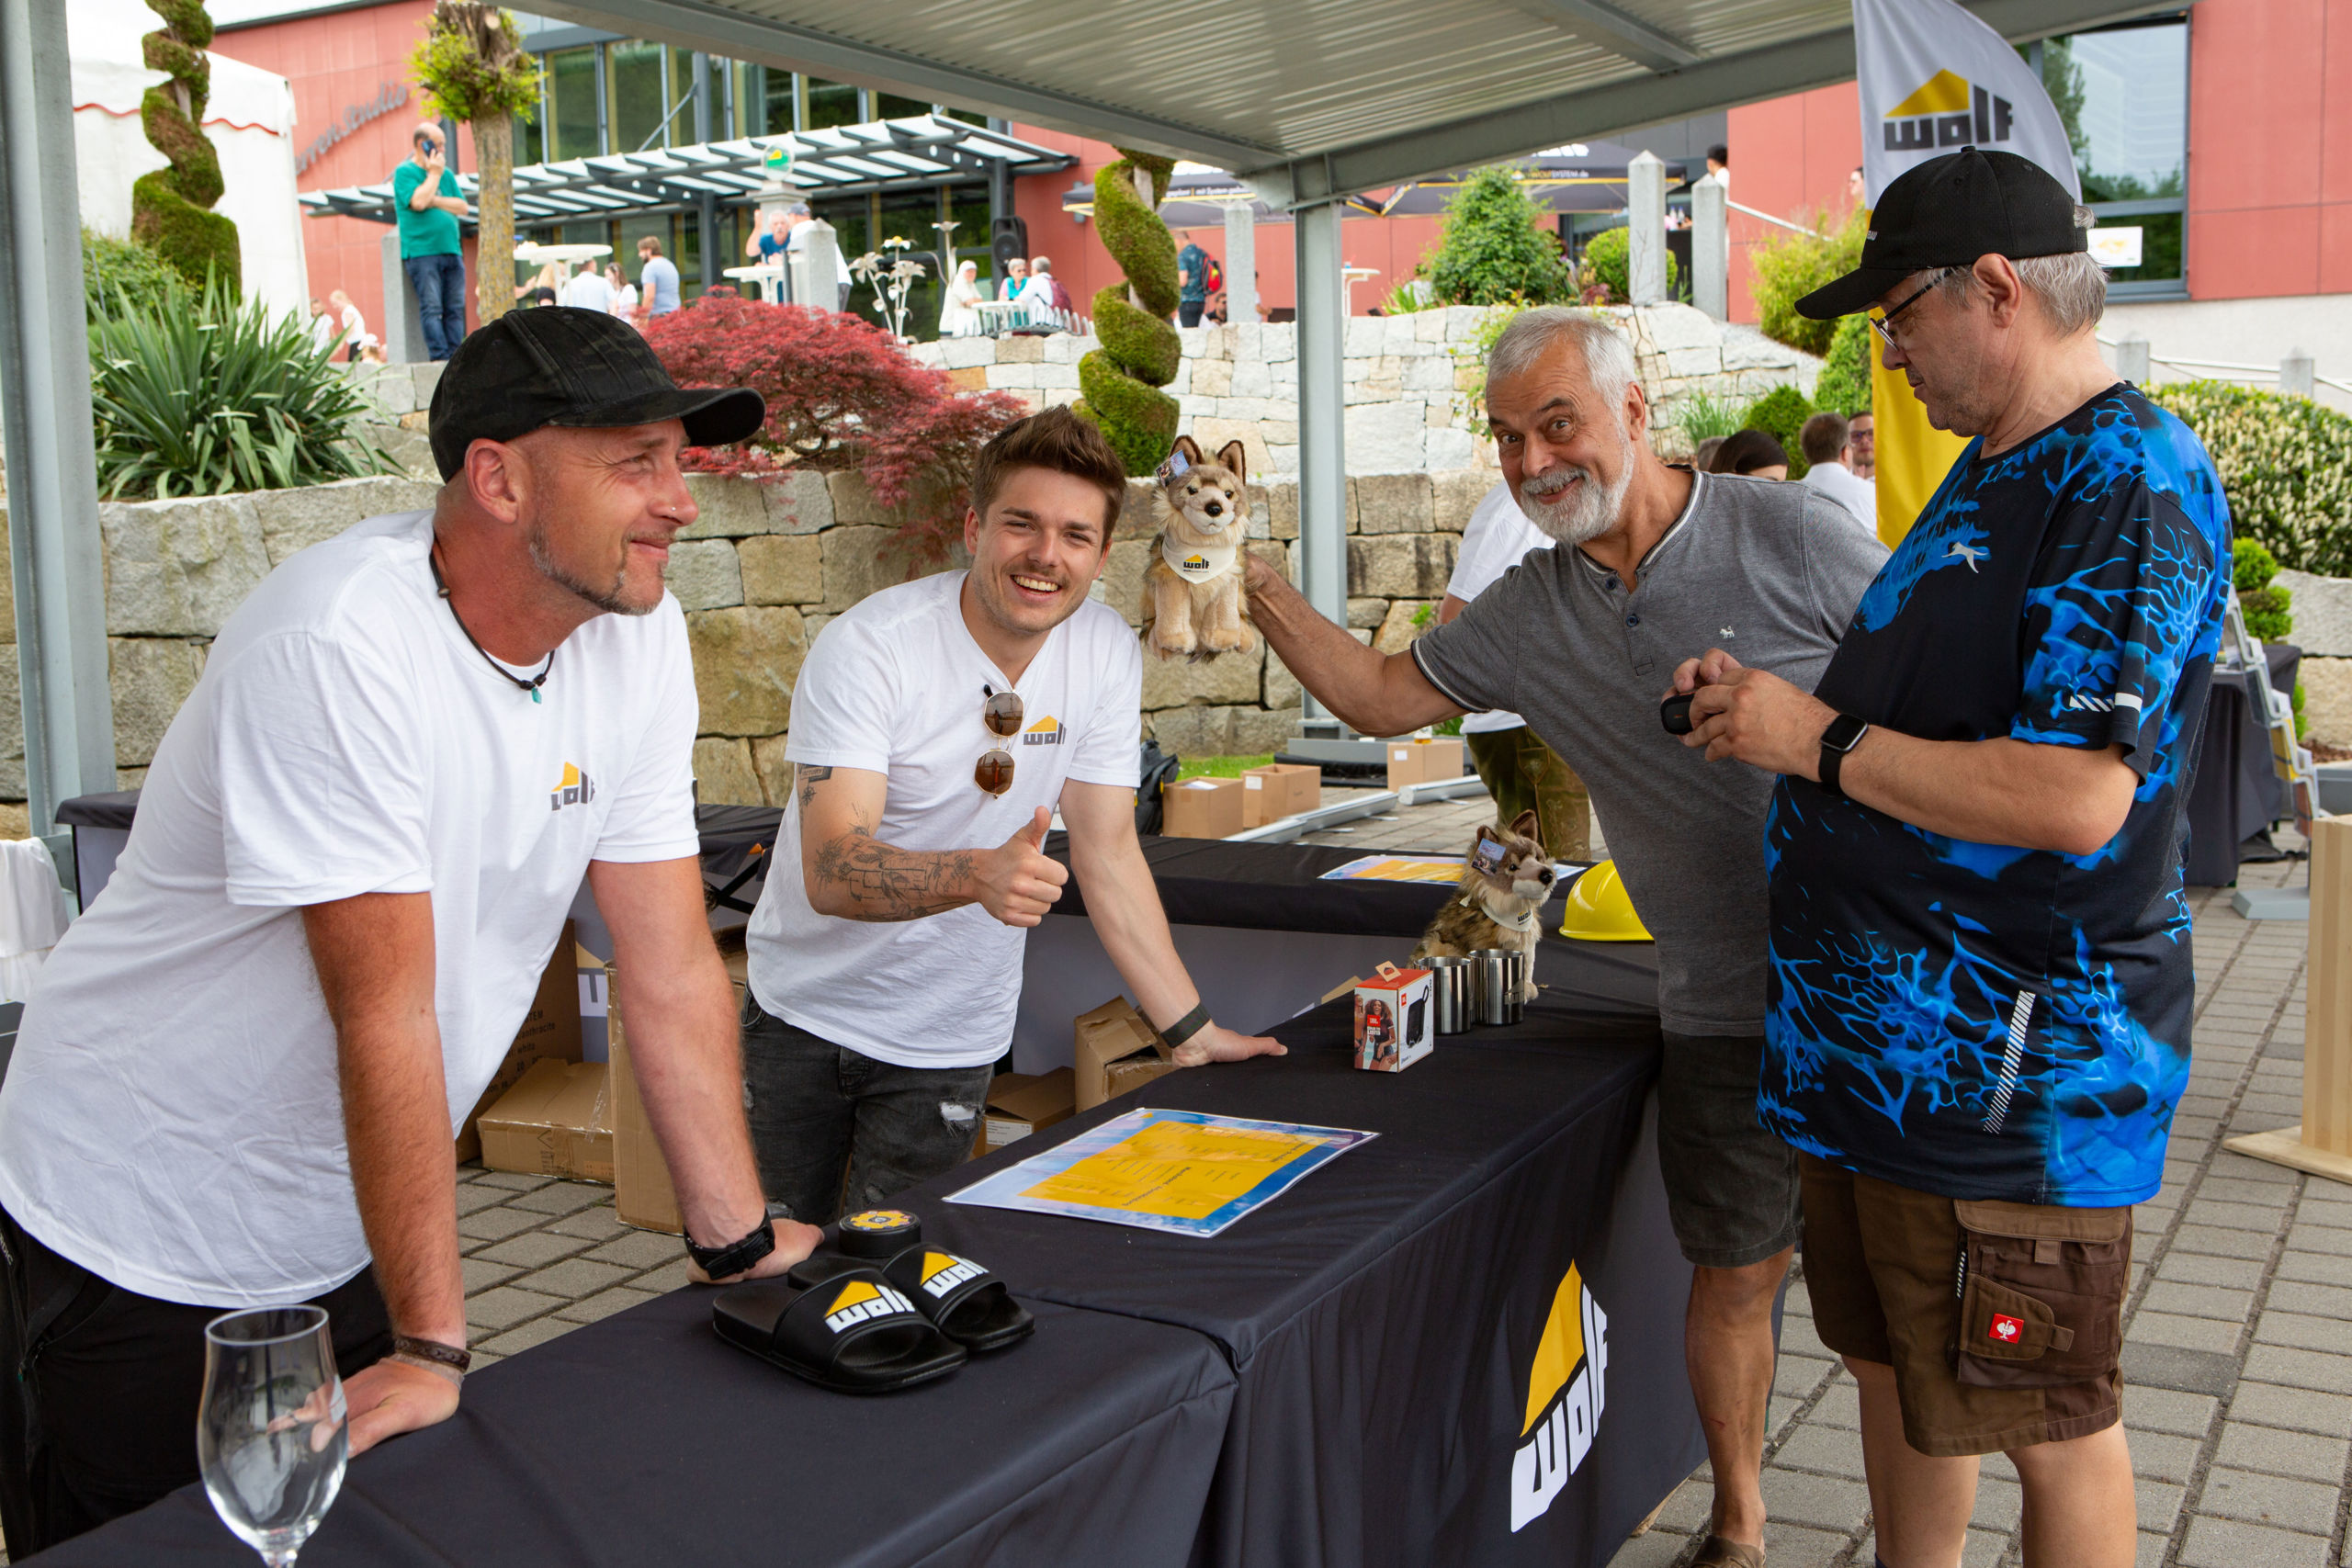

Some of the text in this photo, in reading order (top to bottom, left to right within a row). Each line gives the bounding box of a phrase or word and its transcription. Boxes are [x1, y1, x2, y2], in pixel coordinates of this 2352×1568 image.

[1883, 84, 2013, 152] wolf
[825, 1284, 916, 1334] wolf
[1510, 1282, 1608, 1534] wolf
